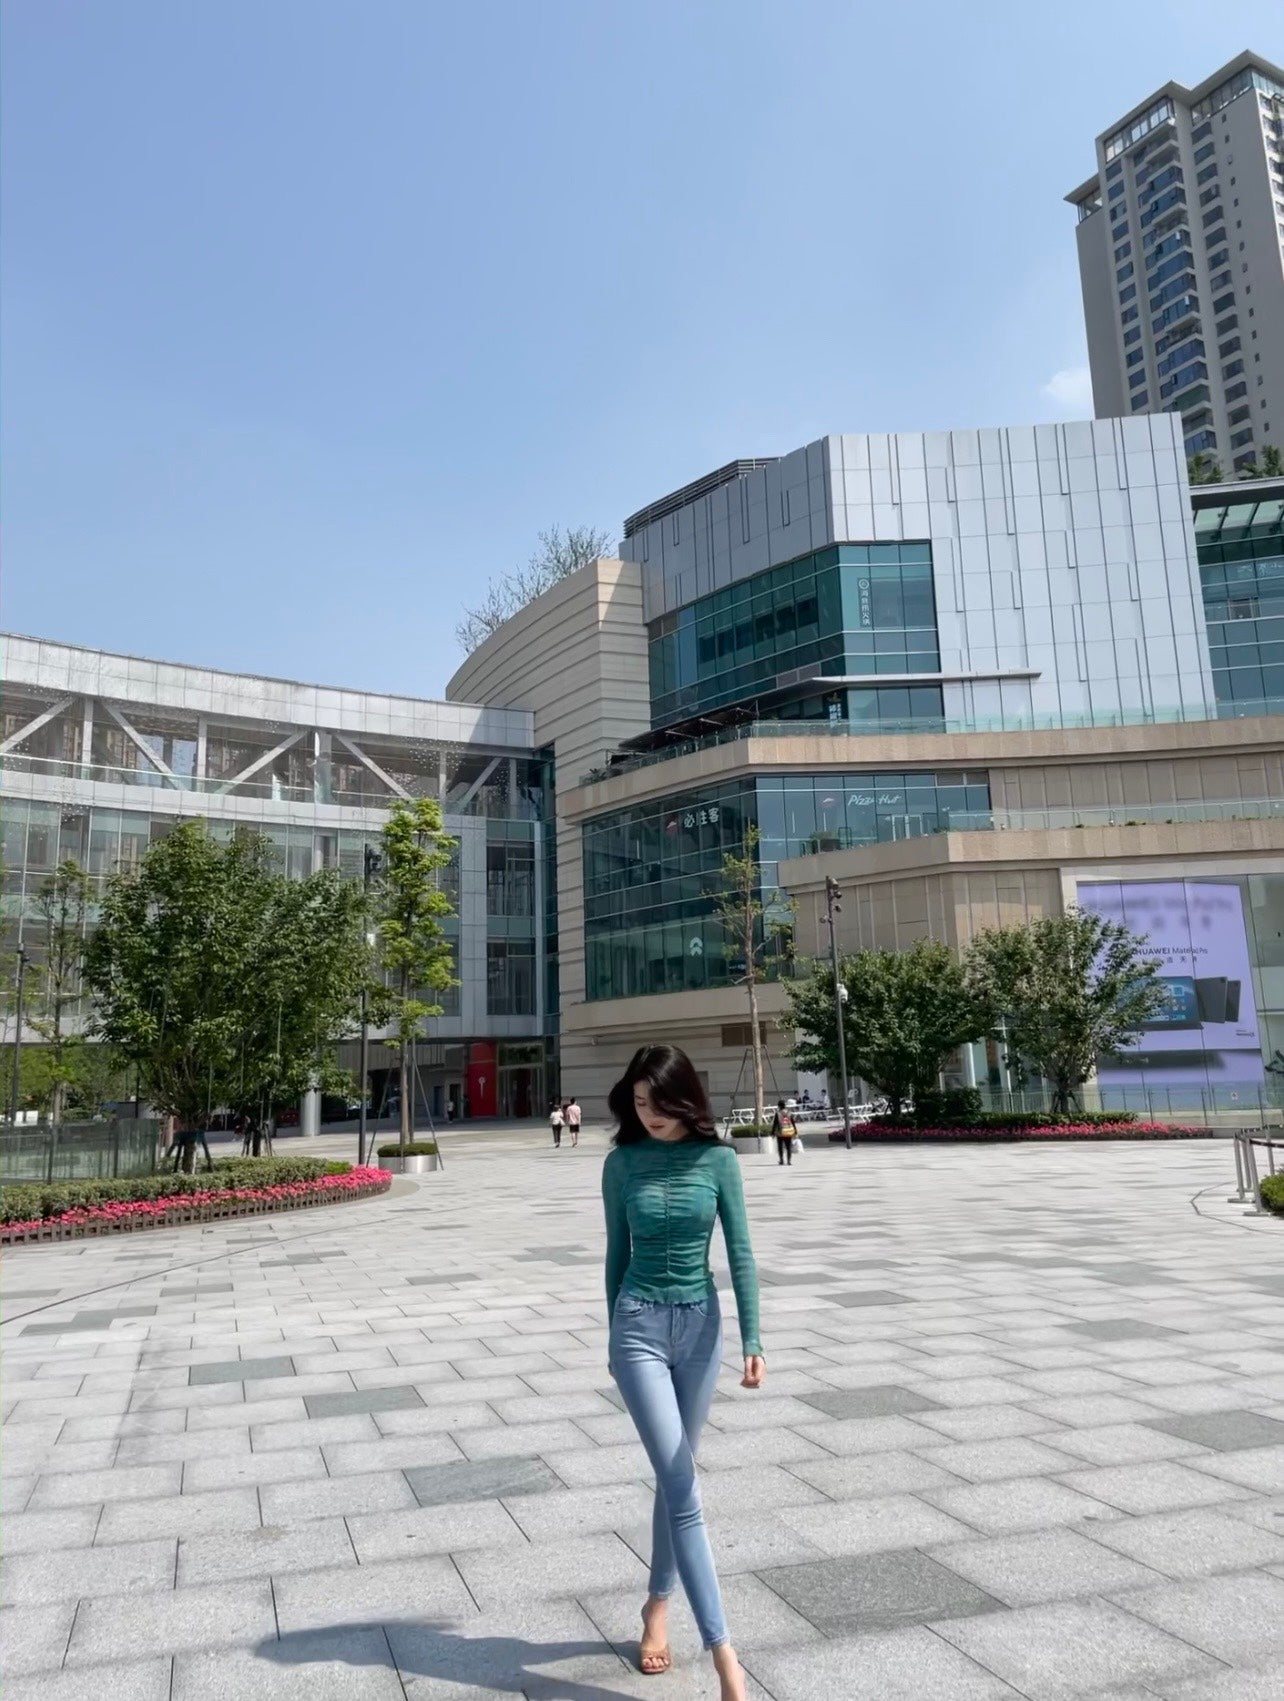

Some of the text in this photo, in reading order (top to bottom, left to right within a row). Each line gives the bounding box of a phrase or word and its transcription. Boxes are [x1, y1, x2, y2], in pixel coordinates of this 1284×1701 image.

[847, 794, 901, 806] Pizza Hut
[683, 807, 719, 828] 必胜客
